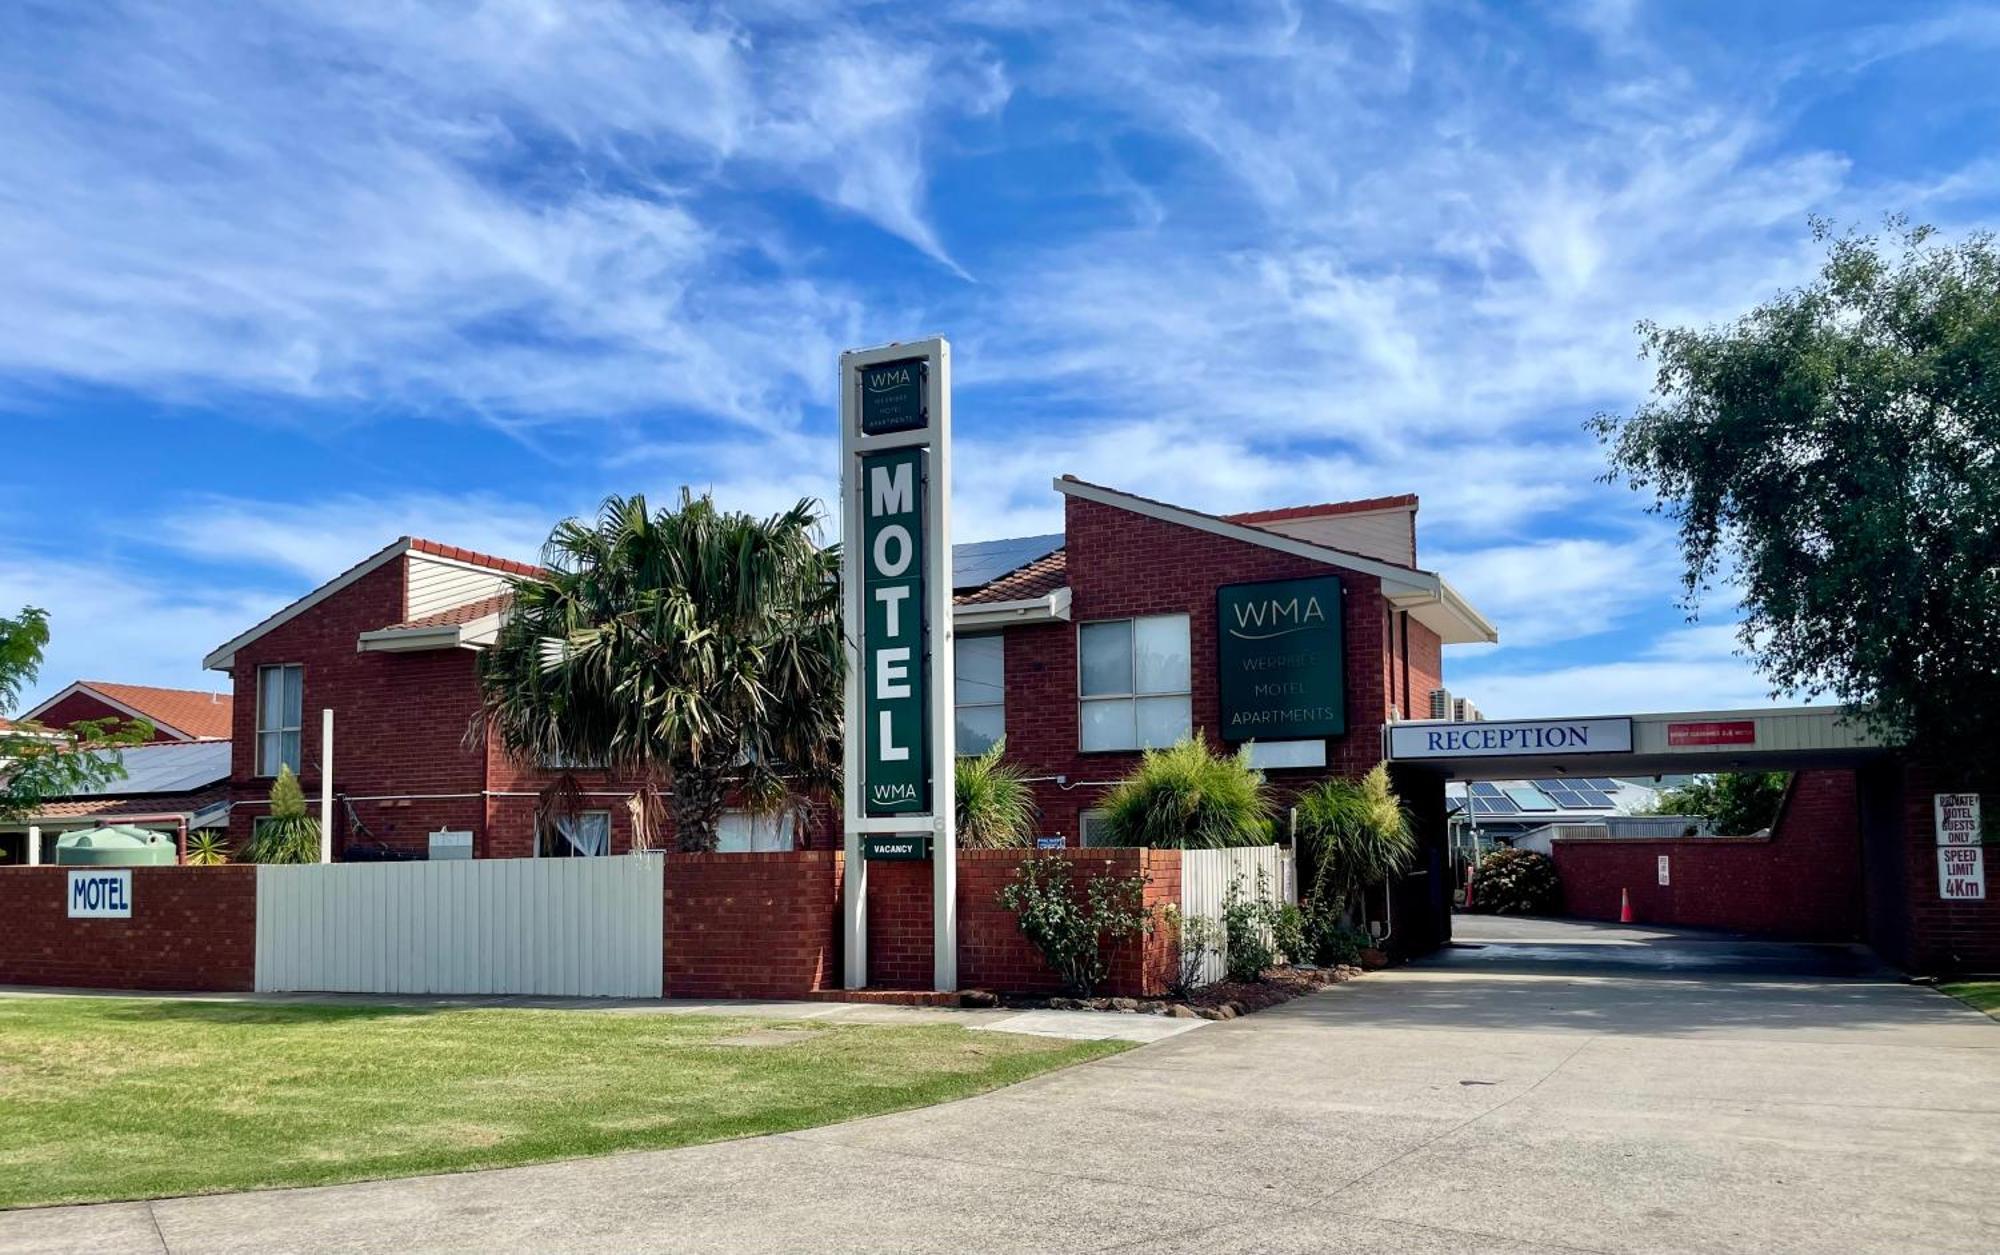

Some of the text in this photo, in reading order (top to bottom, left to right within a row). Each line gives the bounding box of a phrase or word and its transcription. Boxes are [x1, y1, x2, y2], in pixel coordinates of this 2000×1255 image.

[871, 369, 909, 387] WMA
[871, 462, 914, 761] MOTEL
[1233, 596, 1325, 629] WMA
[1254, 682, 1305, 698] MOTEL
[1232, 707, 1334, 725] APARTMENTS
[1427, 726, 1589, 751] RECEPTION
[874, 784, 917, 799] WMA
[1943, 807, 1972, 819] MOTEL
[1942, 820, 1976, 832] GUESTS
[1948, 832, 1970, 844] ONLY
[874, 845, 912, 853] VACANCY
[1944, 849, 1977, 863] SPEED
[1947, 863, 1975, 876] LIMIT
[74, 878, 128, 910] MOTEL
[1946, 879, 1979, 897] 4Km
